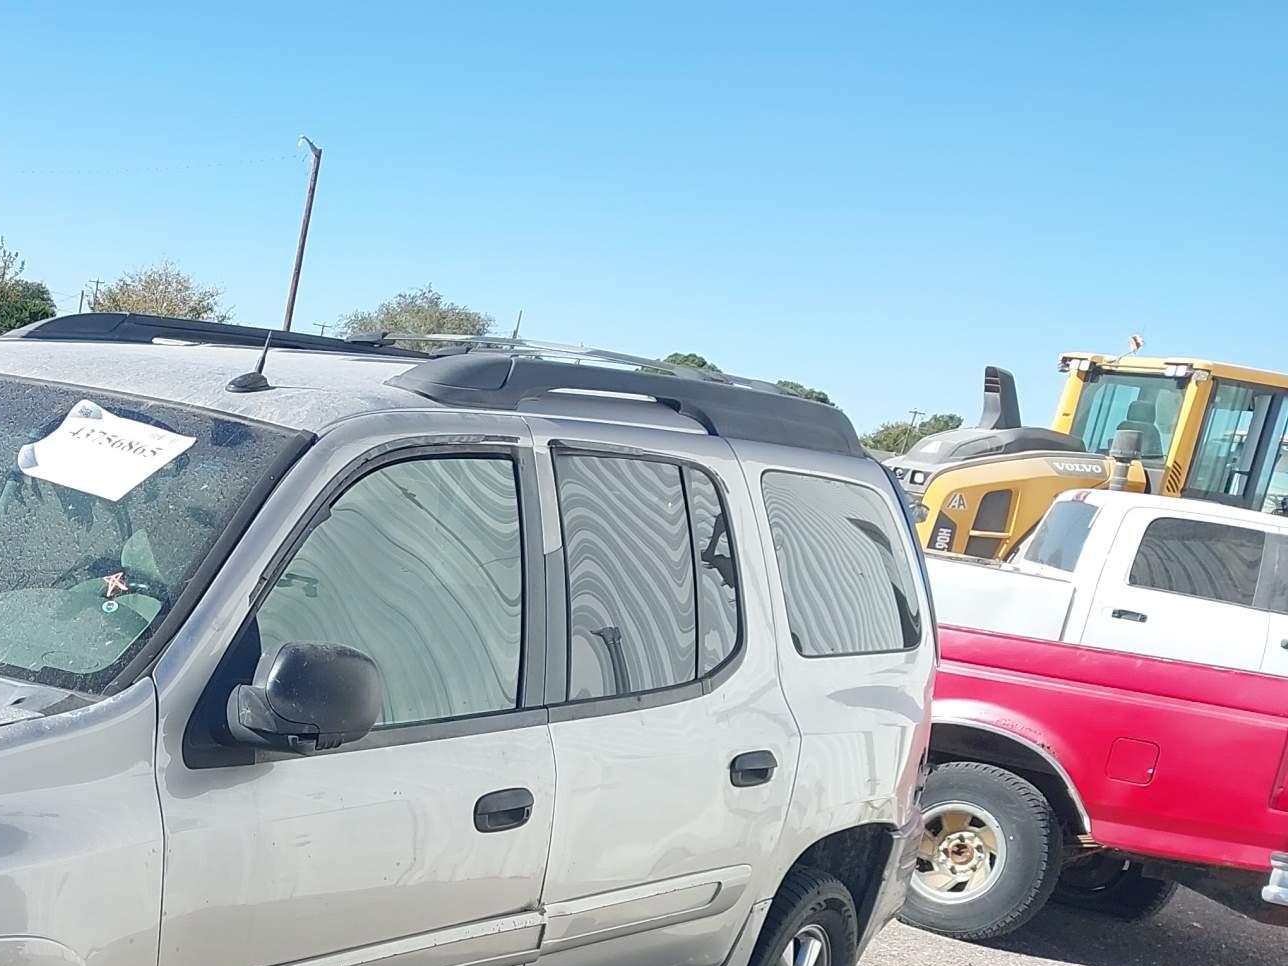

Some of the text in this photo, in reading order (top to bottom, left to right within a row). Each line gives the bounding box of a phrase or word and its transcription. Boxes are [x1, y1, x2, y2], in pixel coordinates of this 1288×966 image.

[68, 427, 164, 459] 43756865
[1053, 462, 1102, 473] VOLVO
[935, 528, 952, 552] 90H
